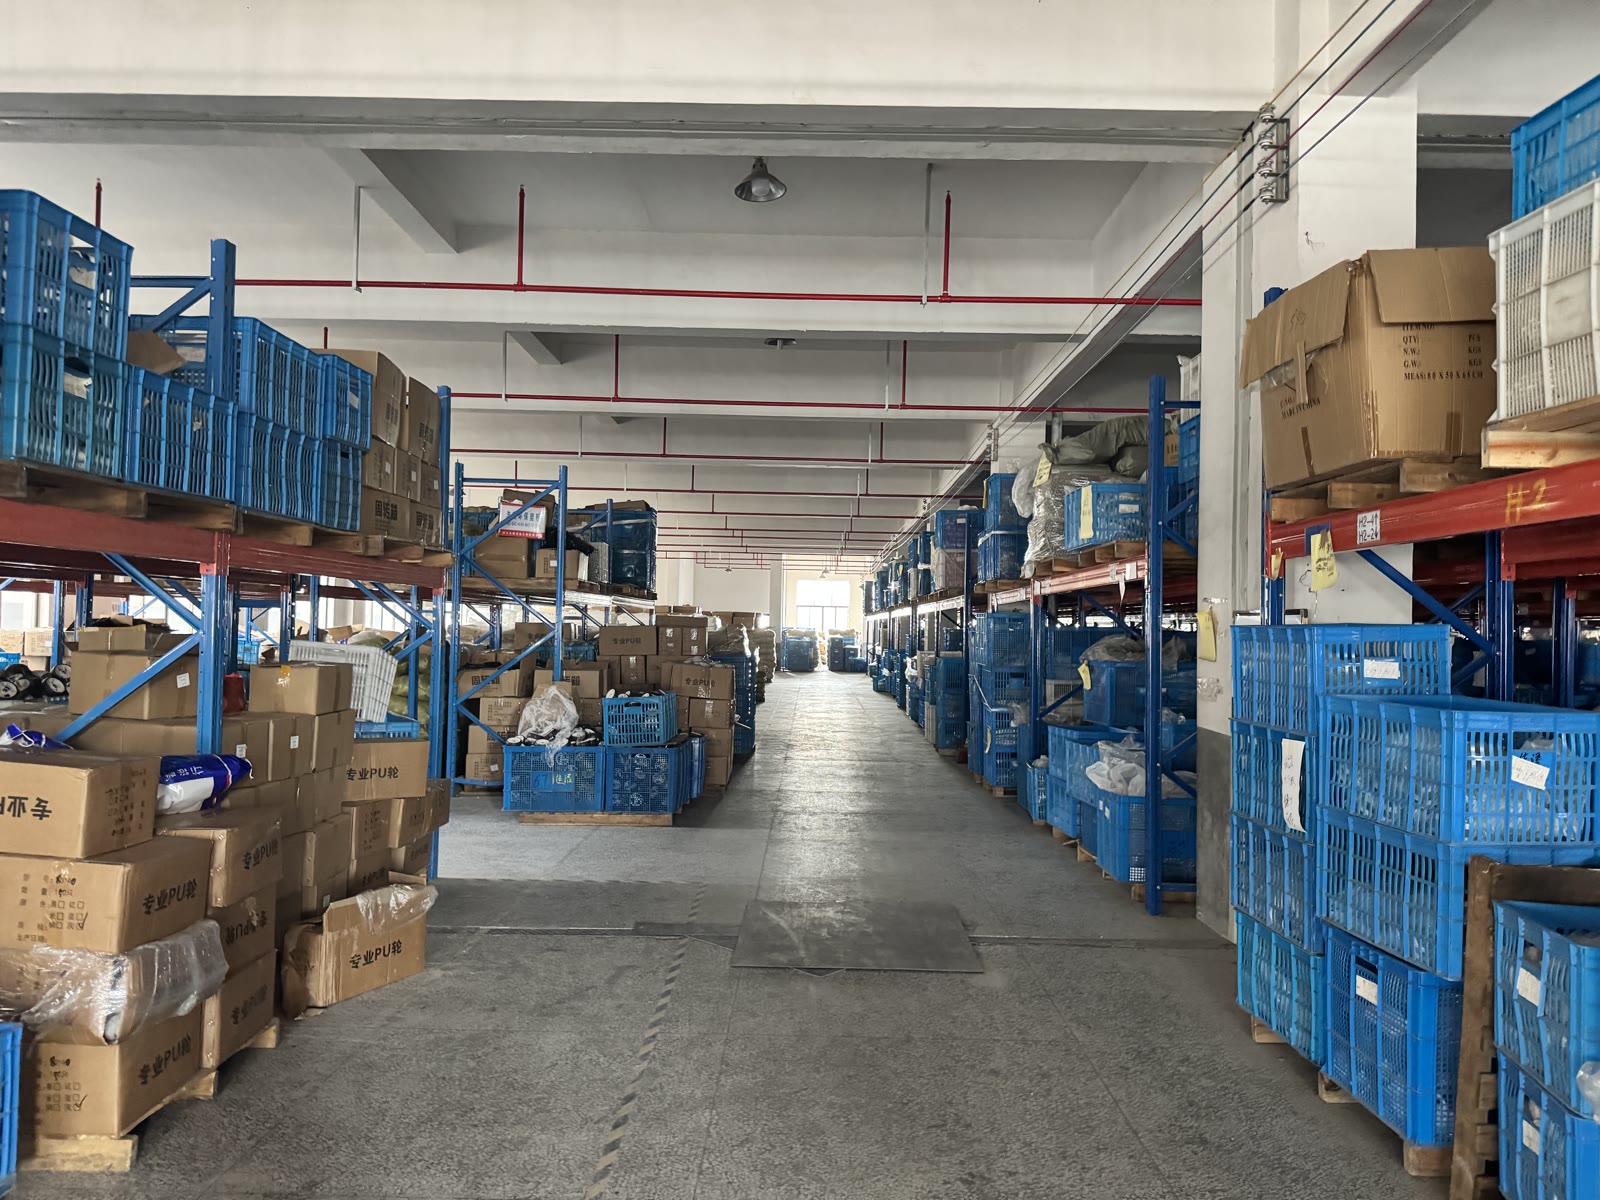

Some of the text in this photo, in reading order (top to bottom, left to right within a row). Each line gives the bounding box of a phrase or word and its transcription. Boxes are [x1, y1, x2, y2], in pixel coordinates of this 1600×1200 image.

[1358, 528, 1374, 541] H2-2
[346, 766, 399, 781] 专业PU轮
[142, 878, 197, 915] 专业PU轮
[350, 939, 402, 969] 专业PU轮
